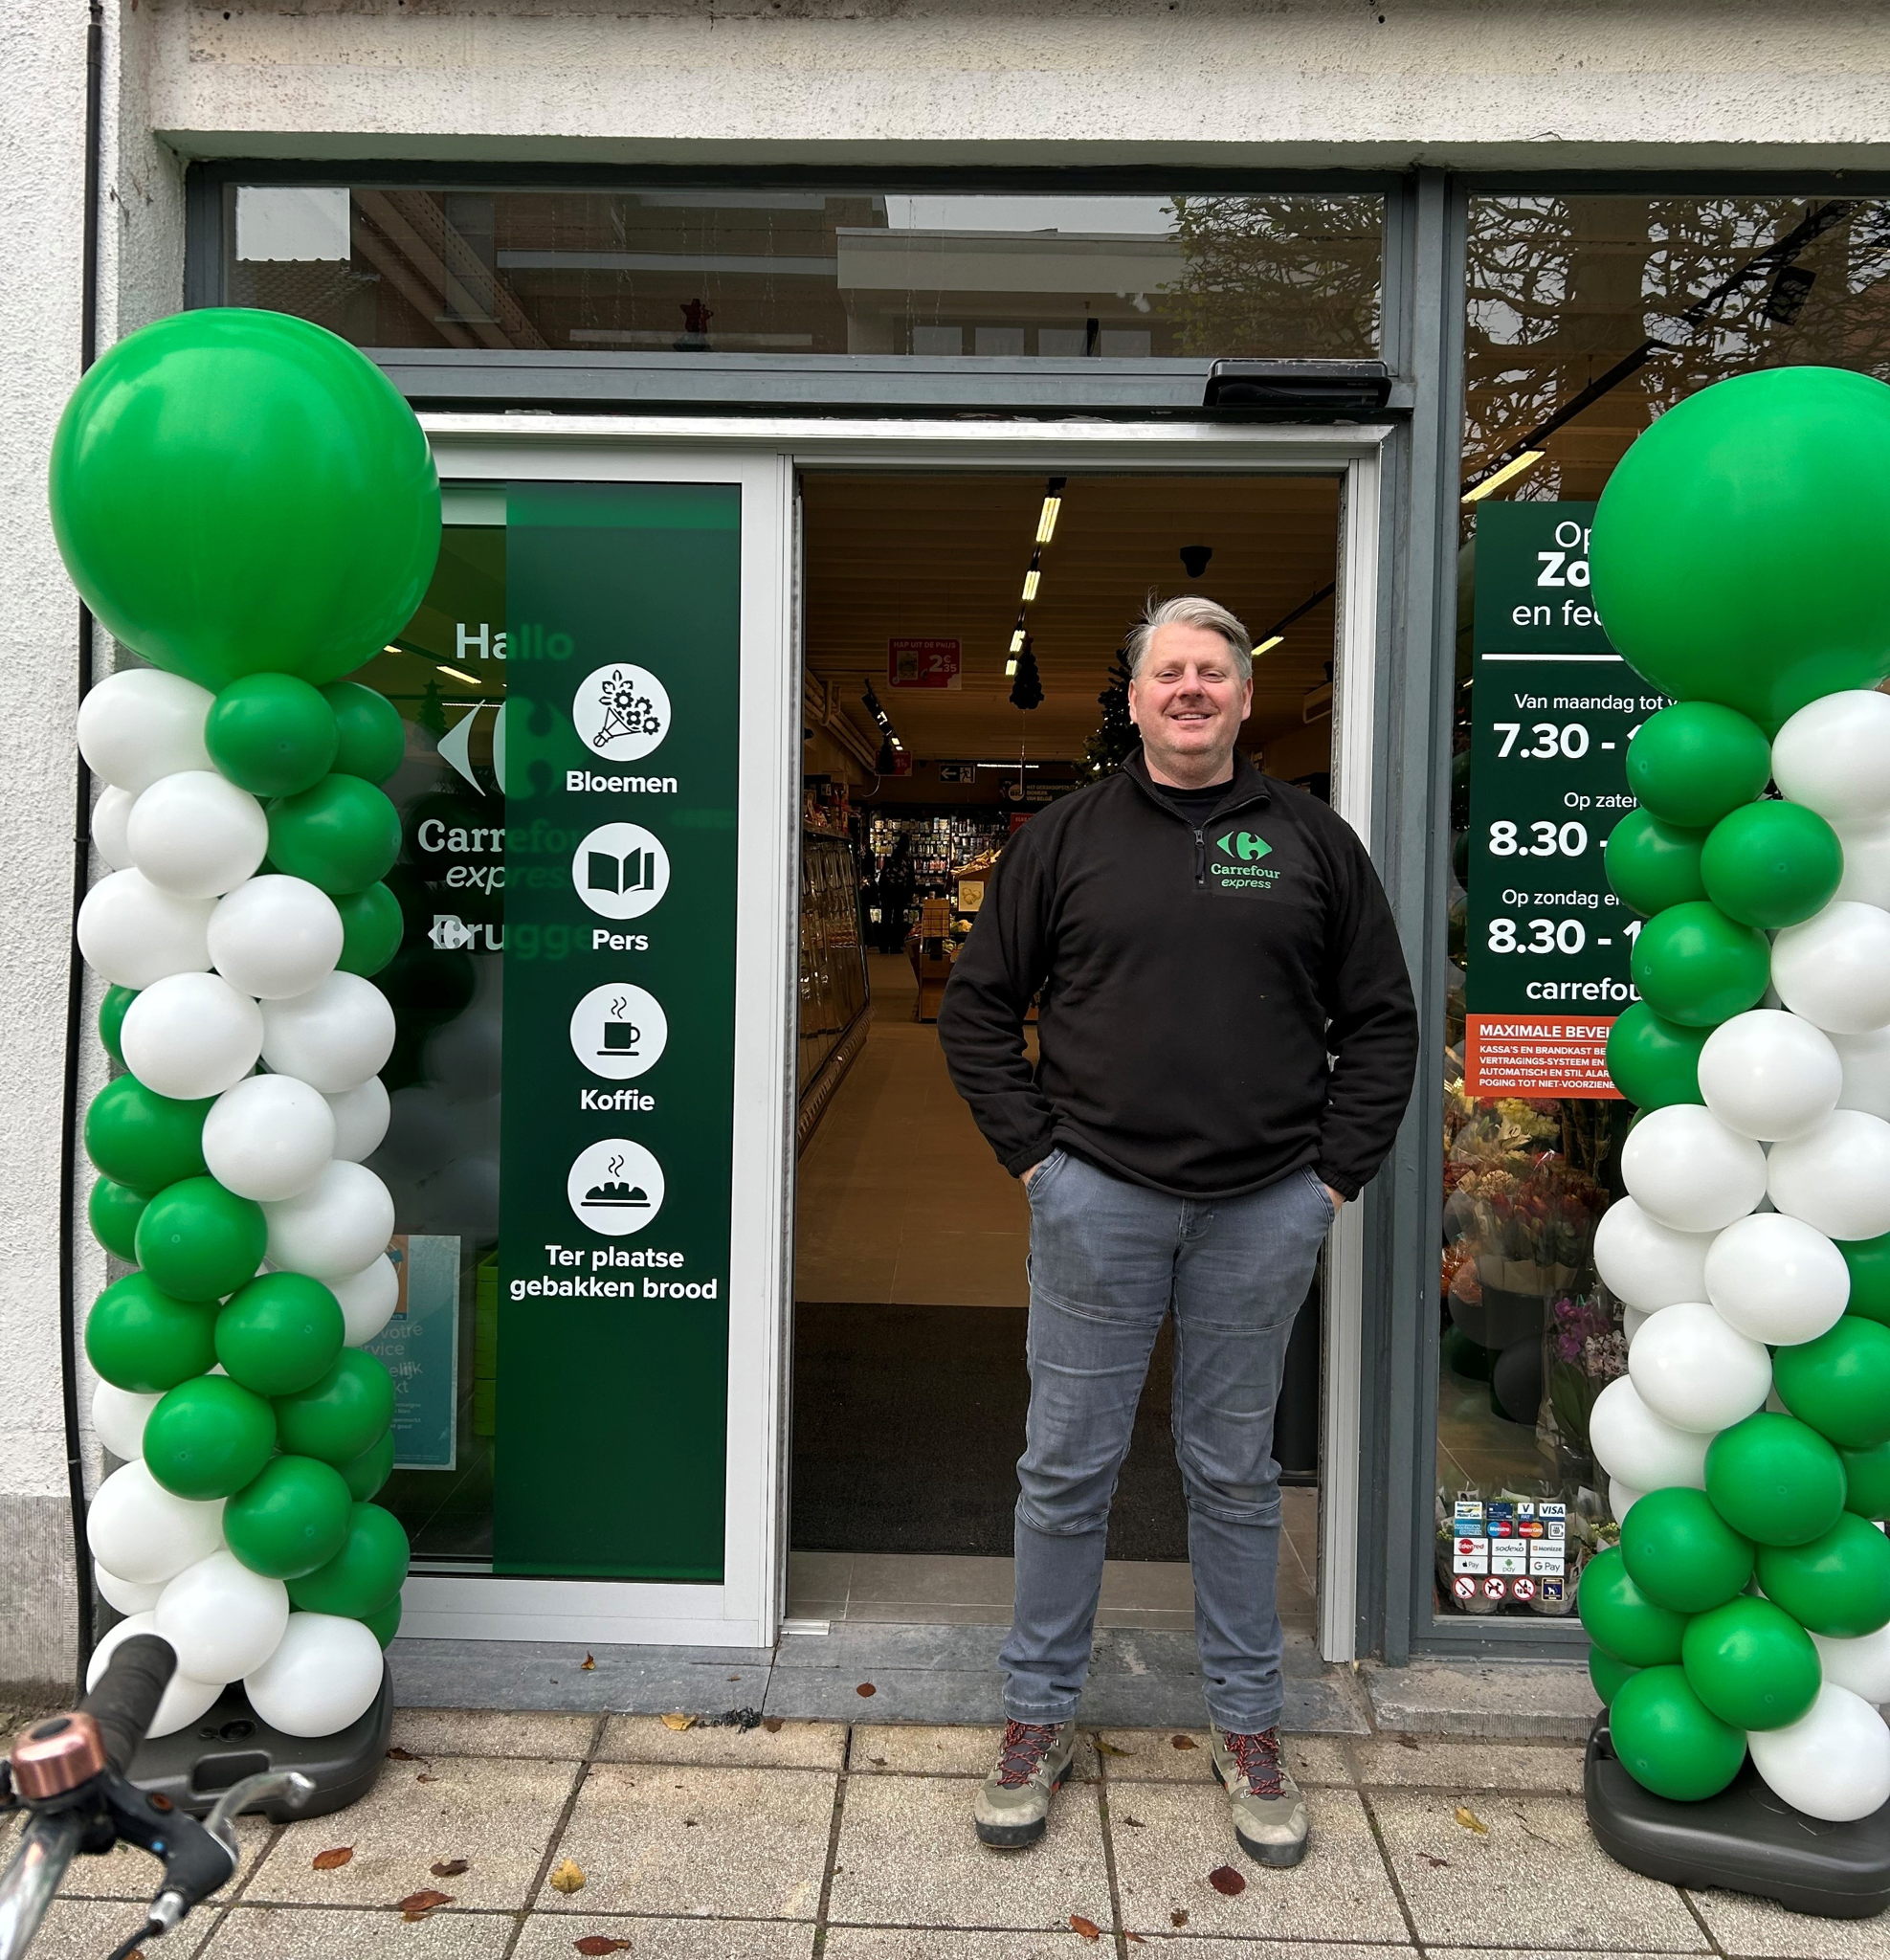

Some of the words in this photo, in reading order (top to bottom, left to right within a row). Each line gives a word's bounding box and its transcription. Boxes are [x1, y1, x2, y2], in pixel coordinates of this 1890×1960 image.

[1512, 605, 1551, 626] en
[1514, 694, 1547, 709] Van
[1553, 694, 1634, 714] maandag
[1639, 696, 1663, 710] tot
[1493, 723, 1590, 759] 7.30
[566, 770, 678, 793] Bloemen
[1564, 792, 1590, 811] Op
[1595, 793, 1637, 808] zater
[1488, 820, 1589, 858] 8.30
[1211, 862, 1281, 880] Carrefour
[1221, 879, 1272, 889] express
[1501, 889, 1529, 907] Op
[1533, 890, 1599, 909] zondag
[592, 929, 649, 950] Pers
[1487, 918, 1586, 954] 8.30
[1525, 977, 1643, 1001] carrefou
[1479, 1024, 1562, 1037] MAXIMALE
[1479, 1045, 1519, 1054] KASSA'S
[1479, 1057, 1590, 1066] VERTRAGINGS-SYSTEEM
[1479, 1067, 1547, 1076] AUTOMATISCH
[1479, 1079, 1516, 1087] POGING
[580, 1089, 656, 1111] Koffie
[545, 1245, 586, 1267] Ter
[591, 1246, 685, 1271] plaatse
[509, 1276, 634, 1301] gebakken
[643, 1279, 718, 1300] brood
[1542, 1505, 1565, 1515] VISA
[1545, 1562, 1561, 1572] Pay
